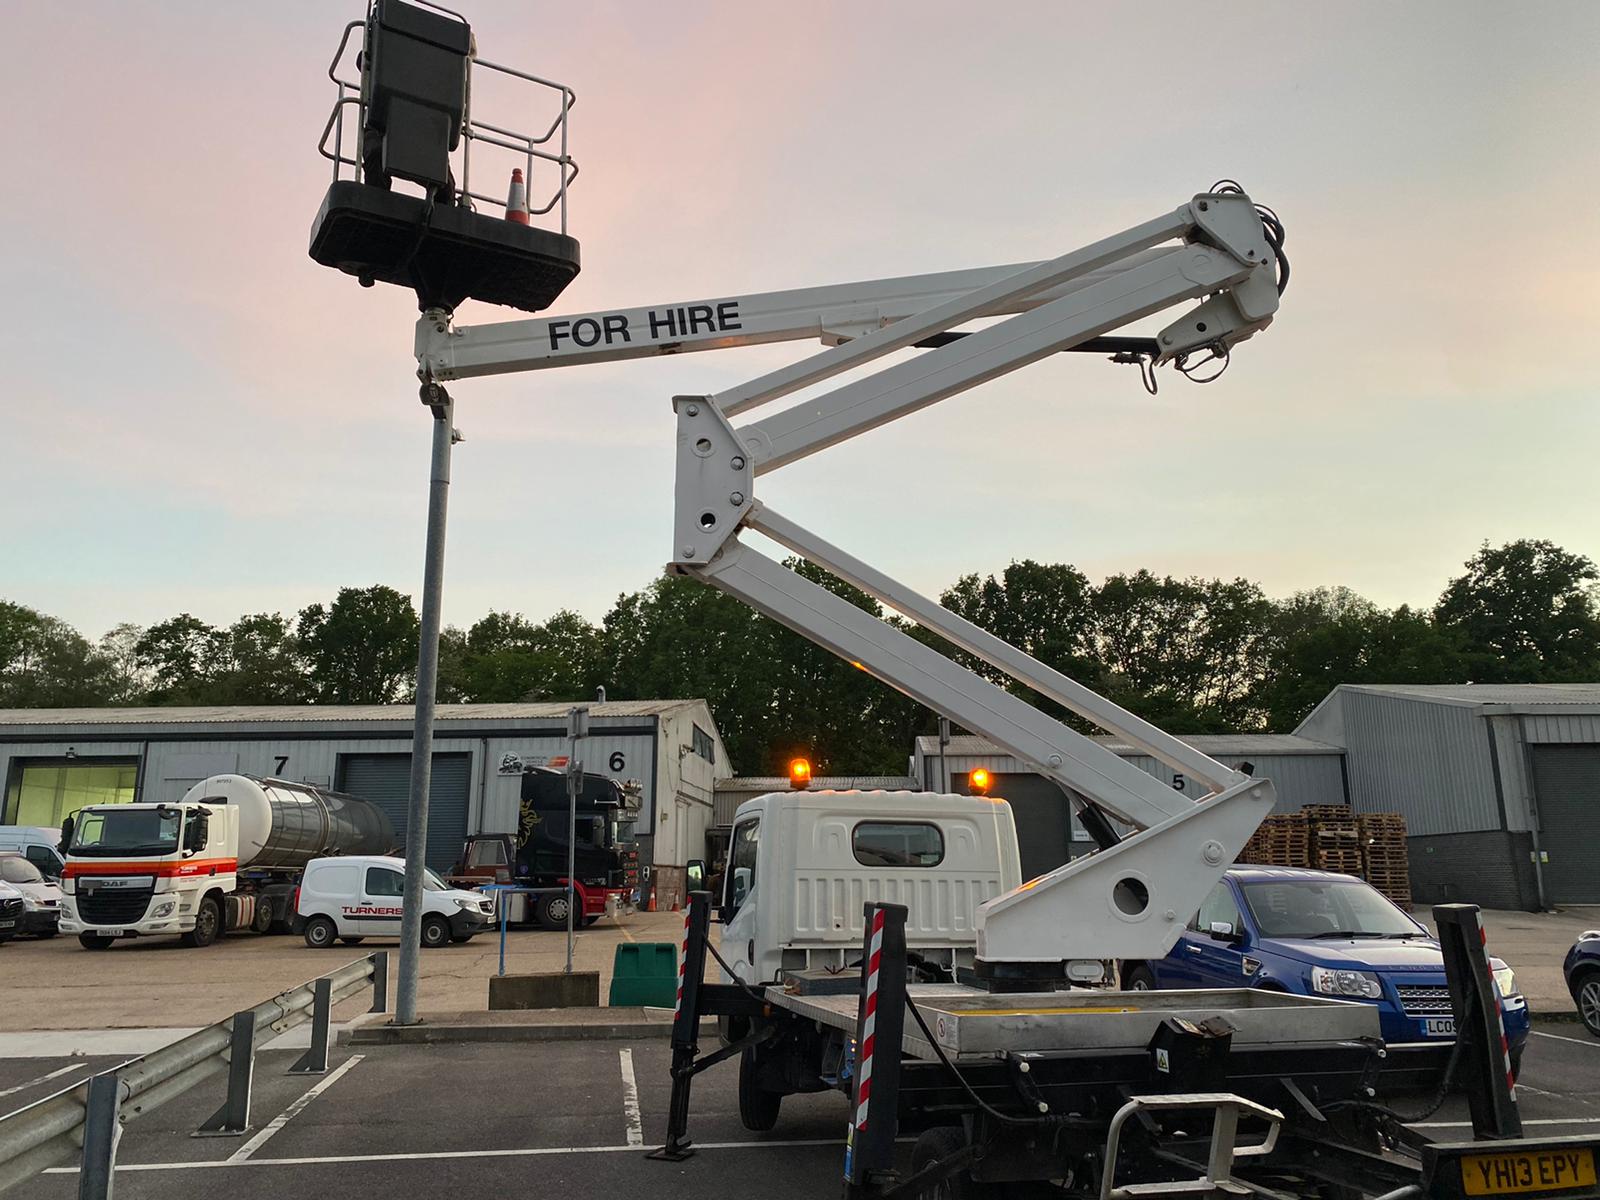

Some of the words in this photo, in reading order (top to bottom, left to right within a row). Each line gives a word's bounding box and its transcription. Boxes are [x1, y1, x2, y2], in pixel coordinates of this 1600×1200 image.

[548, 313, 631, 351] FOR
[648, 301, 742, 339] HIRE
[274, 756, 289, 776] 7
[609, 751, 625, 772] 6
[1172, 774, 1185, 791] 5
[342, 906, 404, 915] TURNERS
[1478, 1157, 1533, 1189] YH13
[1538, 1152, 1580, 1185] EPY
